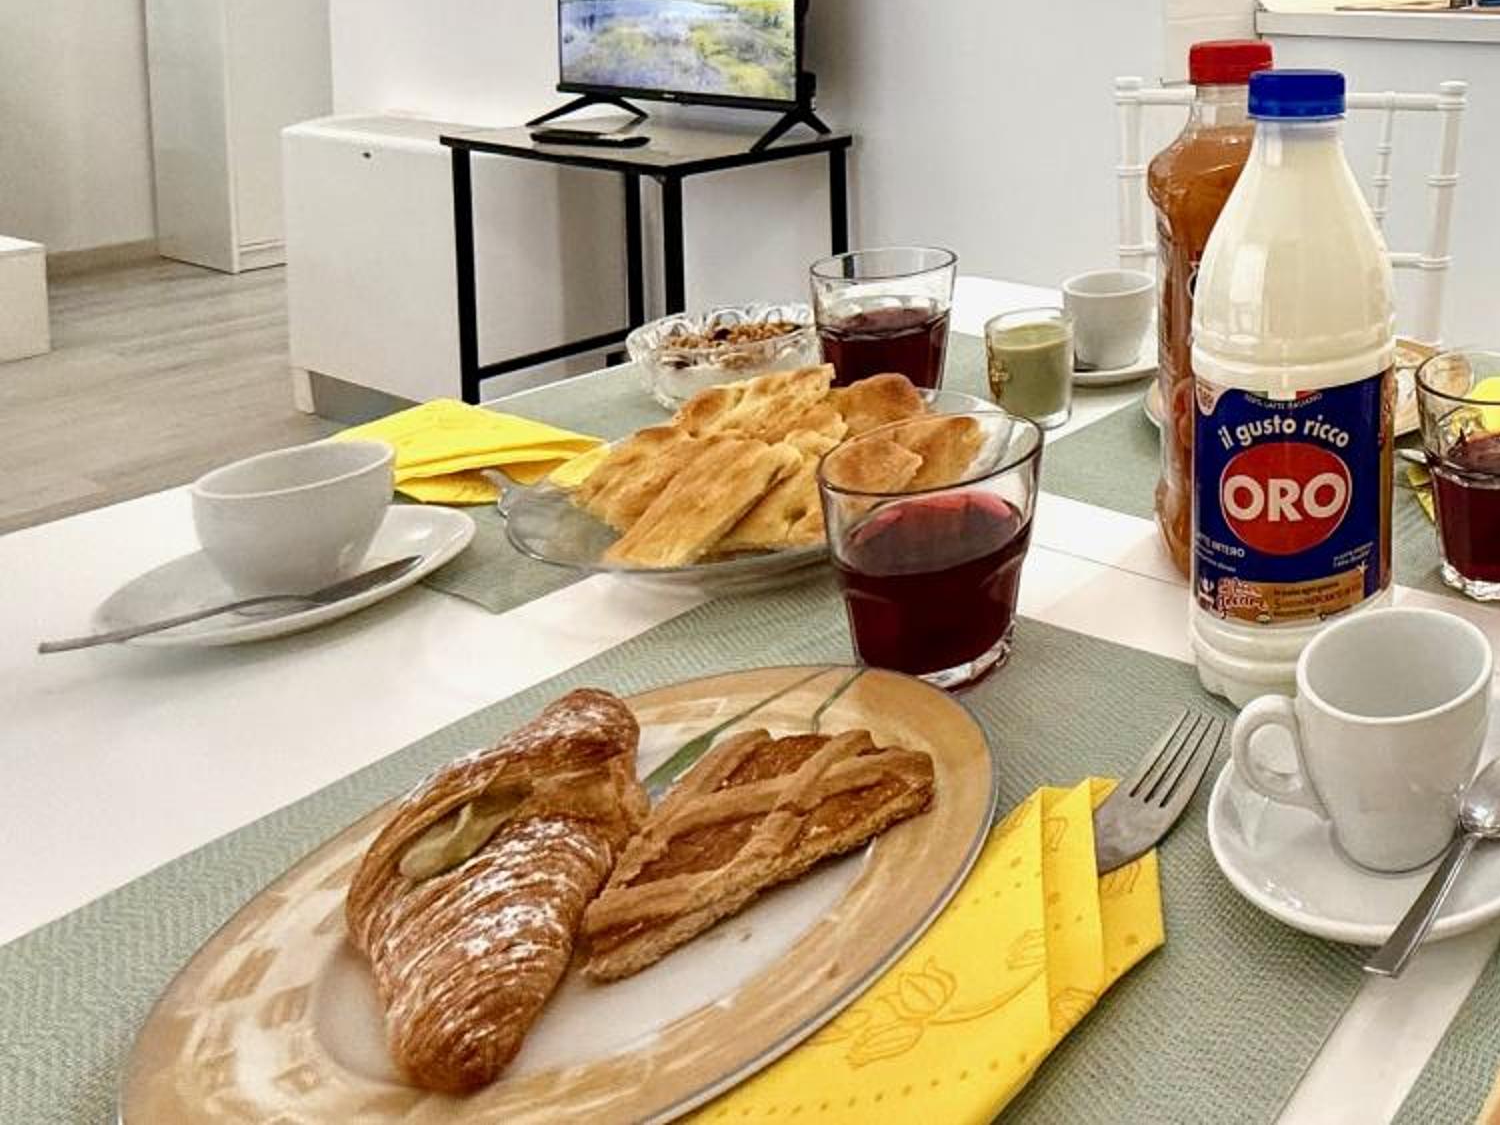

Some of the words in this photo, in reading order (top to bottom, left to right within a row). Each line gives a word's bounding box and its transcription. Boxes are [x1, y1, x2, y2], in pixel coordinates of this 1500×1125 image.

[1217, 425, 1235, 451] il
[1235, 414, 1297, 447] gusto
[1303, 414, 1350, 448] ricco
[1222, 472, 1347, 522] ORO
